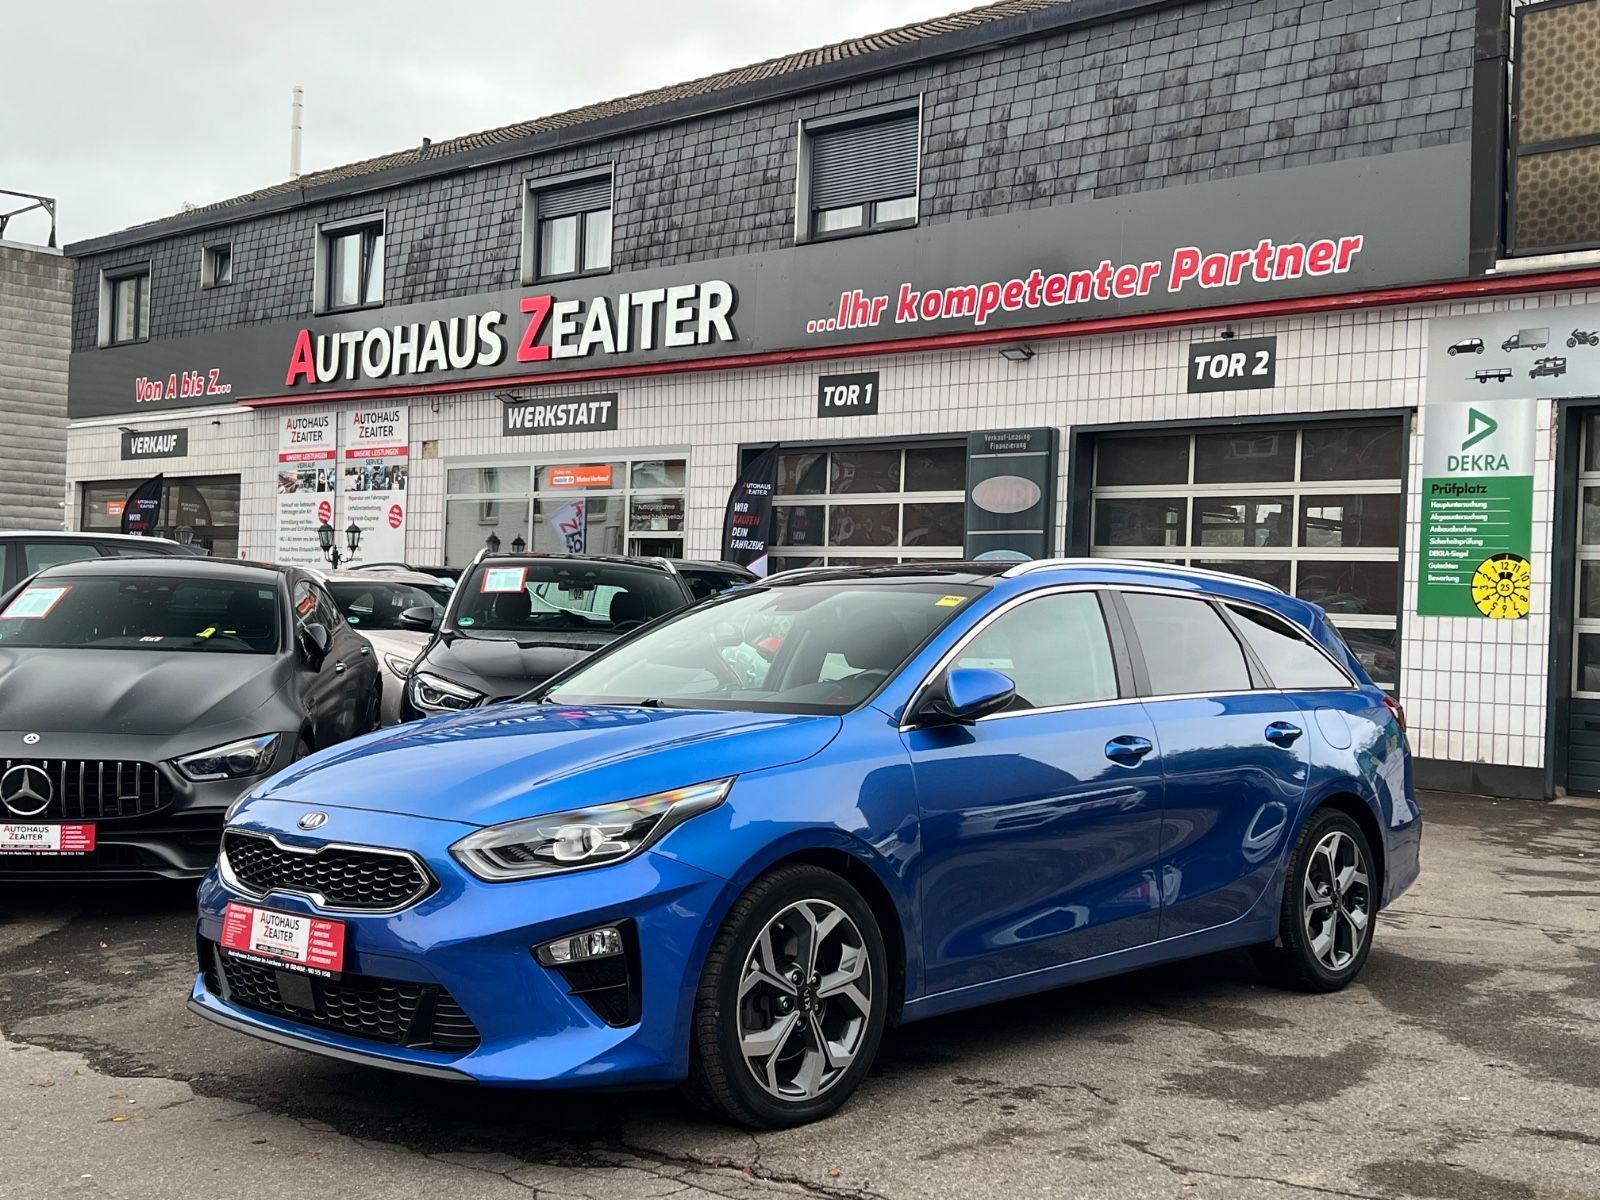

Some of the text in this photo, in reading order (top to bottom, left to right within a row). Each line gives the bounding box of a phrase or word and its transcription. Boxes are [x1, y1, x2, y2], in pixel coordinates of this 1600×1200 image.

[895, 260, 1161, 326] kompetenter
[1168, 234, 1364, 293] Partner
[285, 279, 739, 386] AUTOHAUS ZEAITER
[1194, 350, 1269, 380] TOR 2
[135, 377, 163, 402] Von
[165, 373, 177, 399] A
[180, 370, 205, 398] bis
[823, 383, 873, 407] TOR 1
[353, 410, 400, 425] AUTOHAUS
[508, 401, 612, 429] WERKSTATT
[286, 416, 329, 430] AUTOHAUS
[291, 430, 323, 443] ZEAITER
[359, 425, 394, 438] ZEAITER
[130, 434, 178, 454] VERKAUF
[990, 442, 1027, 450] Finanzierung
[1447, 454, 1510, 472] DEKRA
[1431, 483, 1487, 496] Prüfplatz
[734, 502, 749, 513] WIR
[1430, 500, 1488, 510] Hauptuntersuchung
[129, 513, 142, 521] WIR
[732, 514, 760, 525] KAUFEN
[1430, 512, 1488, 522] Abgasuntersuchung
[732, 527, 748, 537] DEIN
[1429, 525, 1478, 533] Anbauabnahme
[730, 540, 765, 551] FAHRZEUG
[1429, 537, 1484, 546] Sicherheitsprüfung
[1428, 550, 1469, 559] DEKRA-Siegel
[1491, 565, 1498, 574] 1
[1500, 561, 1510, 571] 12
[1512, 563, 1521, 574] 11
[1427, 574, 1460, 583] Bewertung
[1482, 573, 1492, 581] 2
[1519, 571, 1530, 582] 10
[1500, 584, 1511, 592] 25
[1519, 594, 1529, 603] 8
[1490, 601, 1498, 611] 5
[1501, 604, 1508, 614] 6
[1513, 601, 1519, 611] 7
[301, 813, 323, 826] KIA
[4, 825, 50, 833] AUTOHAUS
[9, 832, 43, 841] ZEAITER
[260, 911, 300, 931] AUTOHAUS
[263, 925, 294, 943] ZEAITER
[228, 950, 247, 959] Autohaus
